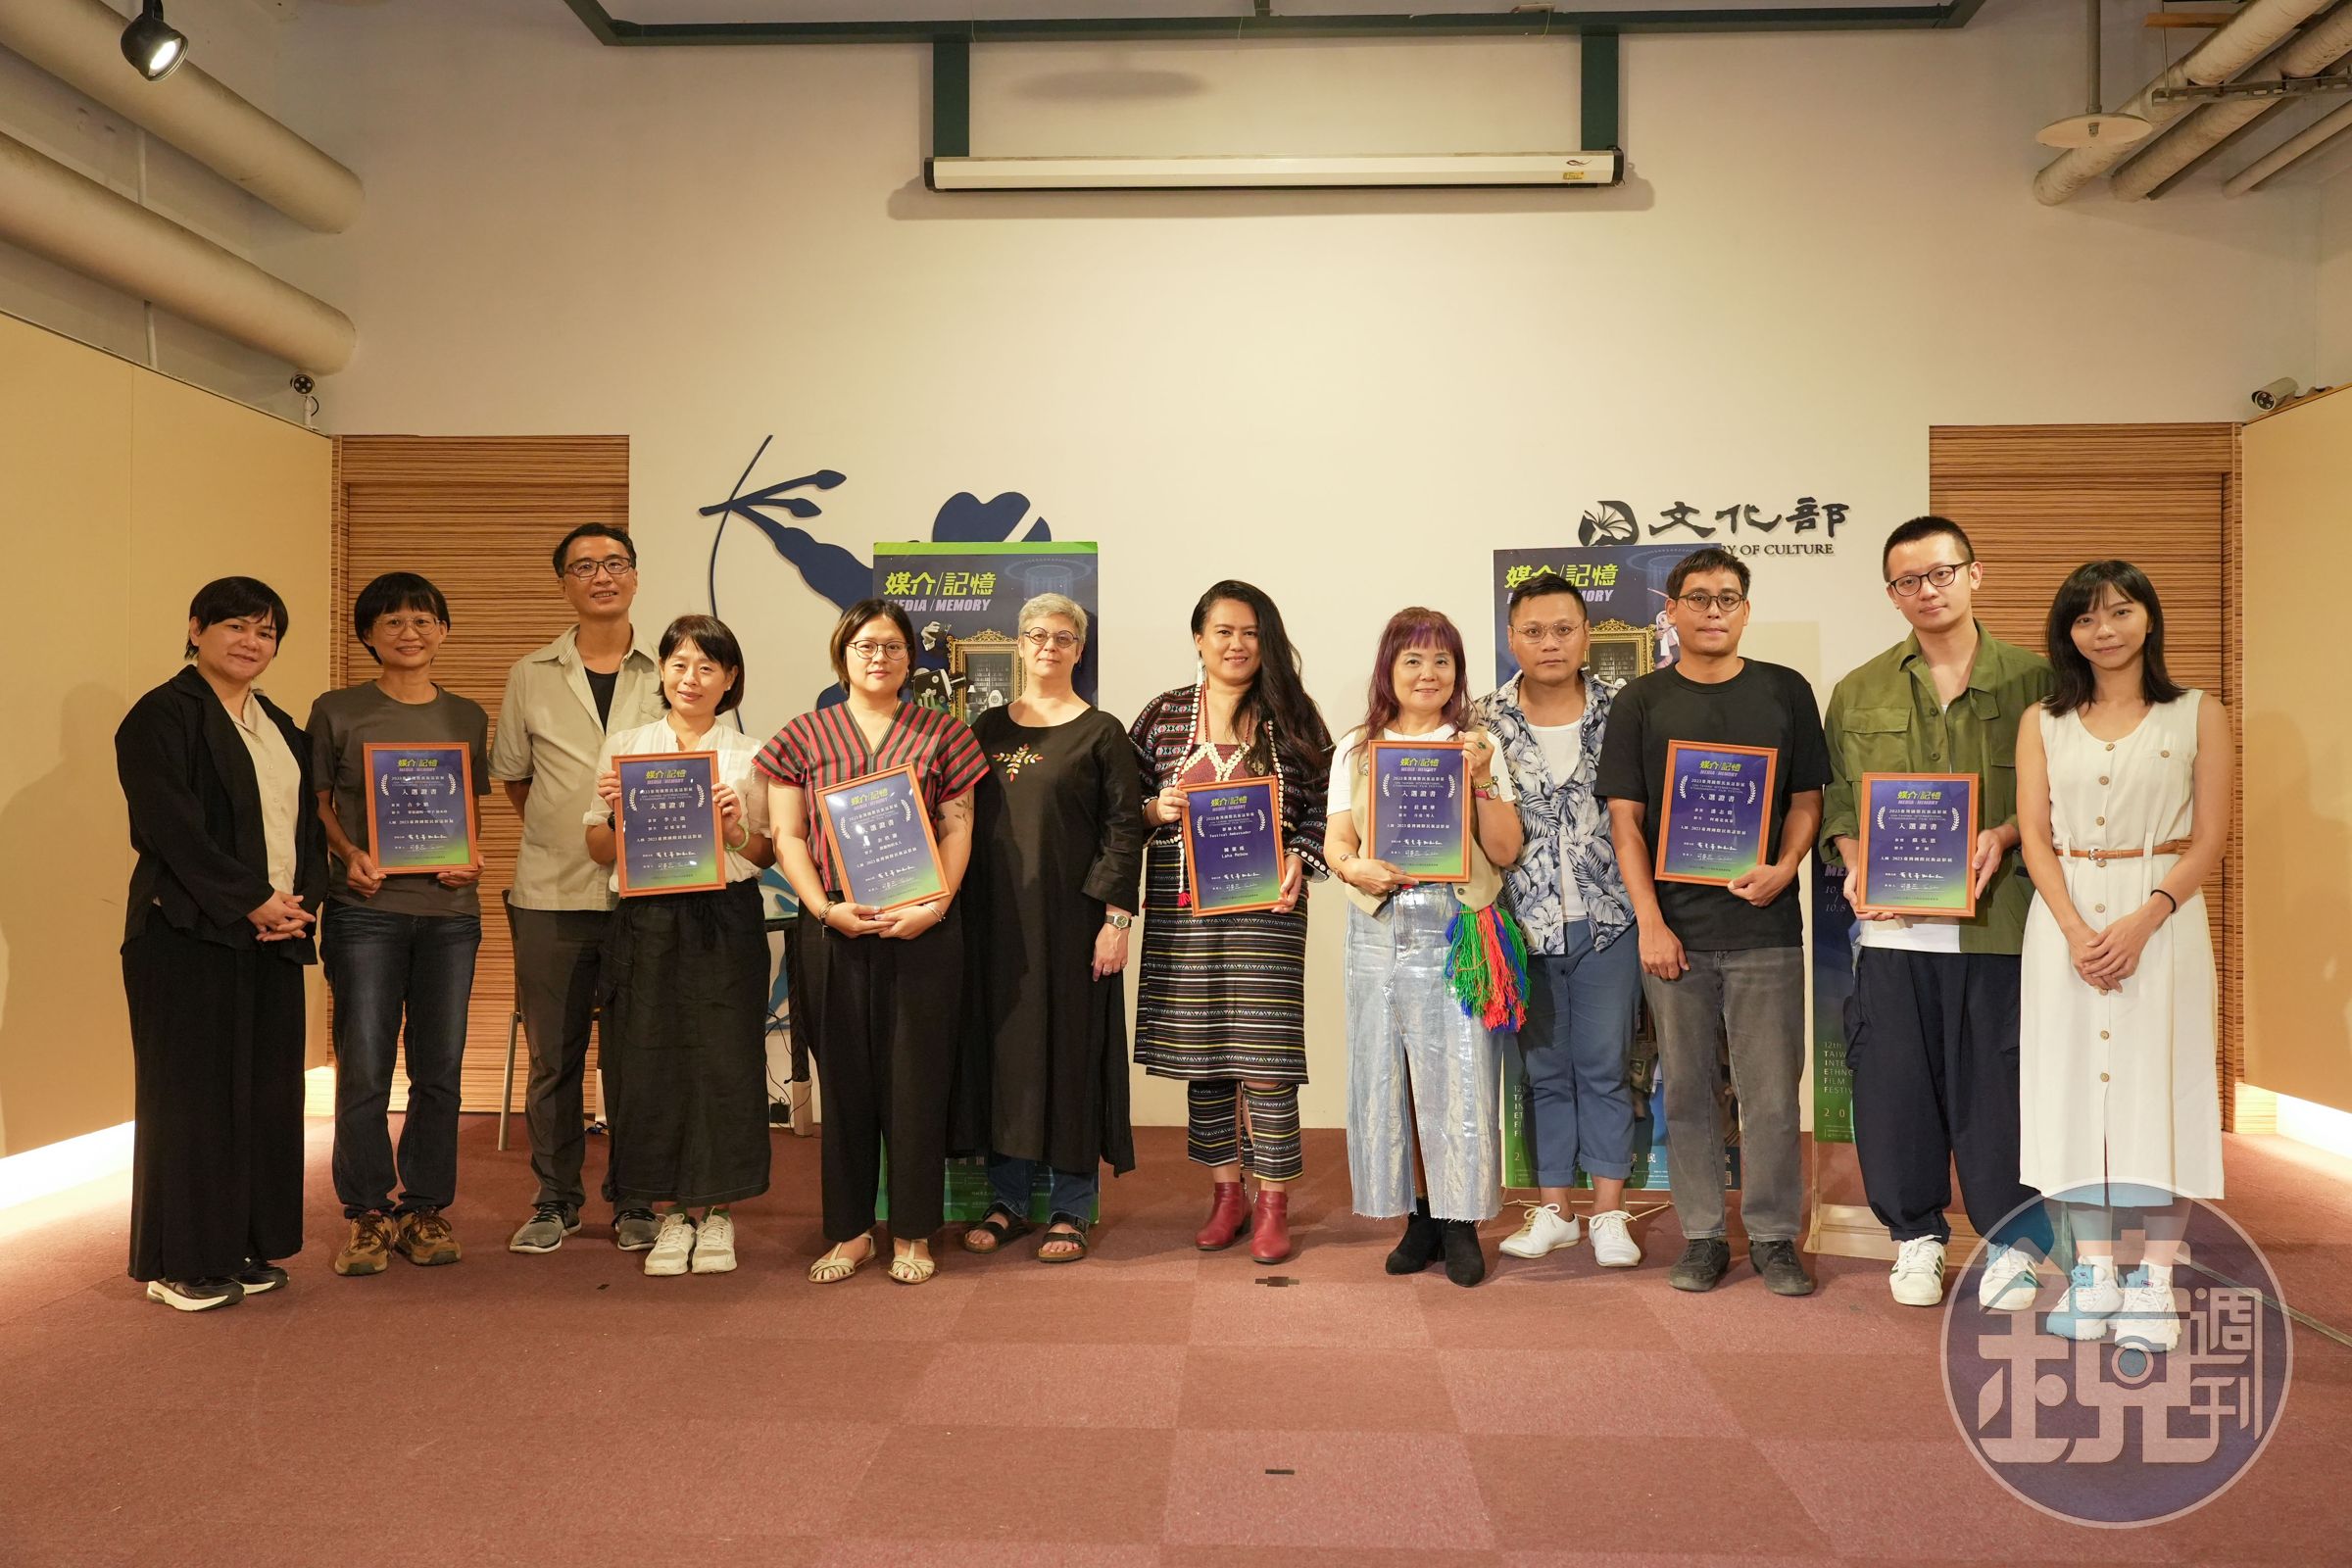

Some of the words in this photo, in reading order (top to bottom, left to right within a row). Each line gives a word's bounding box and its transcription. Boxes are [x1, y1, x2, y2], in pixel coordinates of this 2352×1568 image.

[1648, 496, 1849, 538] 文化部
[1740, 545, 1759, 555] OF
[1764, 544, 1834, 555] CULTURE
[935, 599, 991, 612] MEMORY
